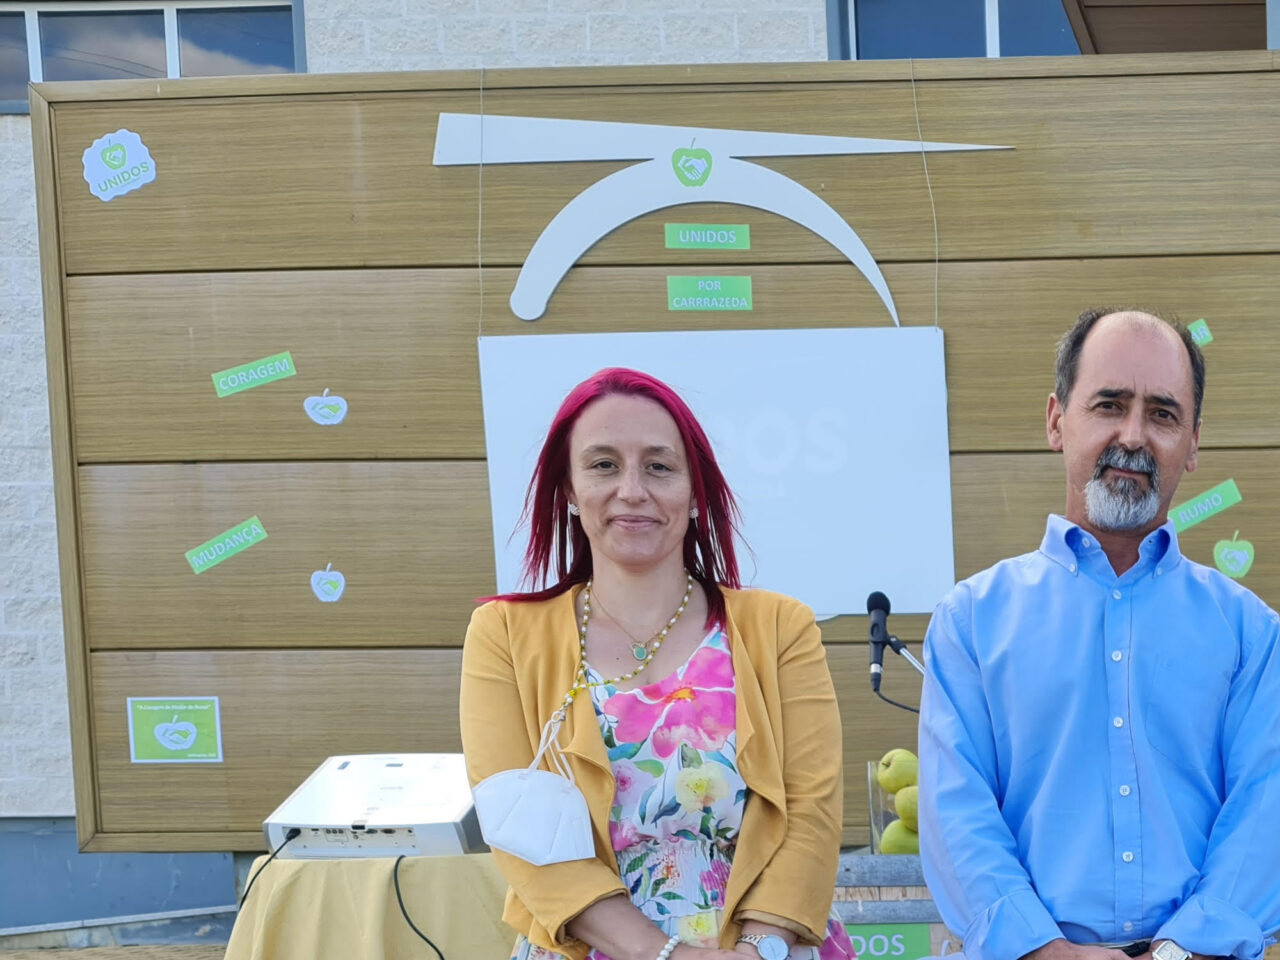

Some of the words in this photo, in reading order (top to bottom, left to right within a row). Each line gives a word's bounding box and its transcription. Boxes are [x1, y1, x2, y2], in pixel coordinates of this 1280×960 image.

[98, 161, 150, 192] UNIDOS
[679, 229, 737, 243] UNIDOS
[698, 280, 722, 291] POR
[219, 358, 290, 390] CORAGEM
[1179, 493, 1223, 523] RUMO
[191, 524, 263, 568] MUDANÇA
